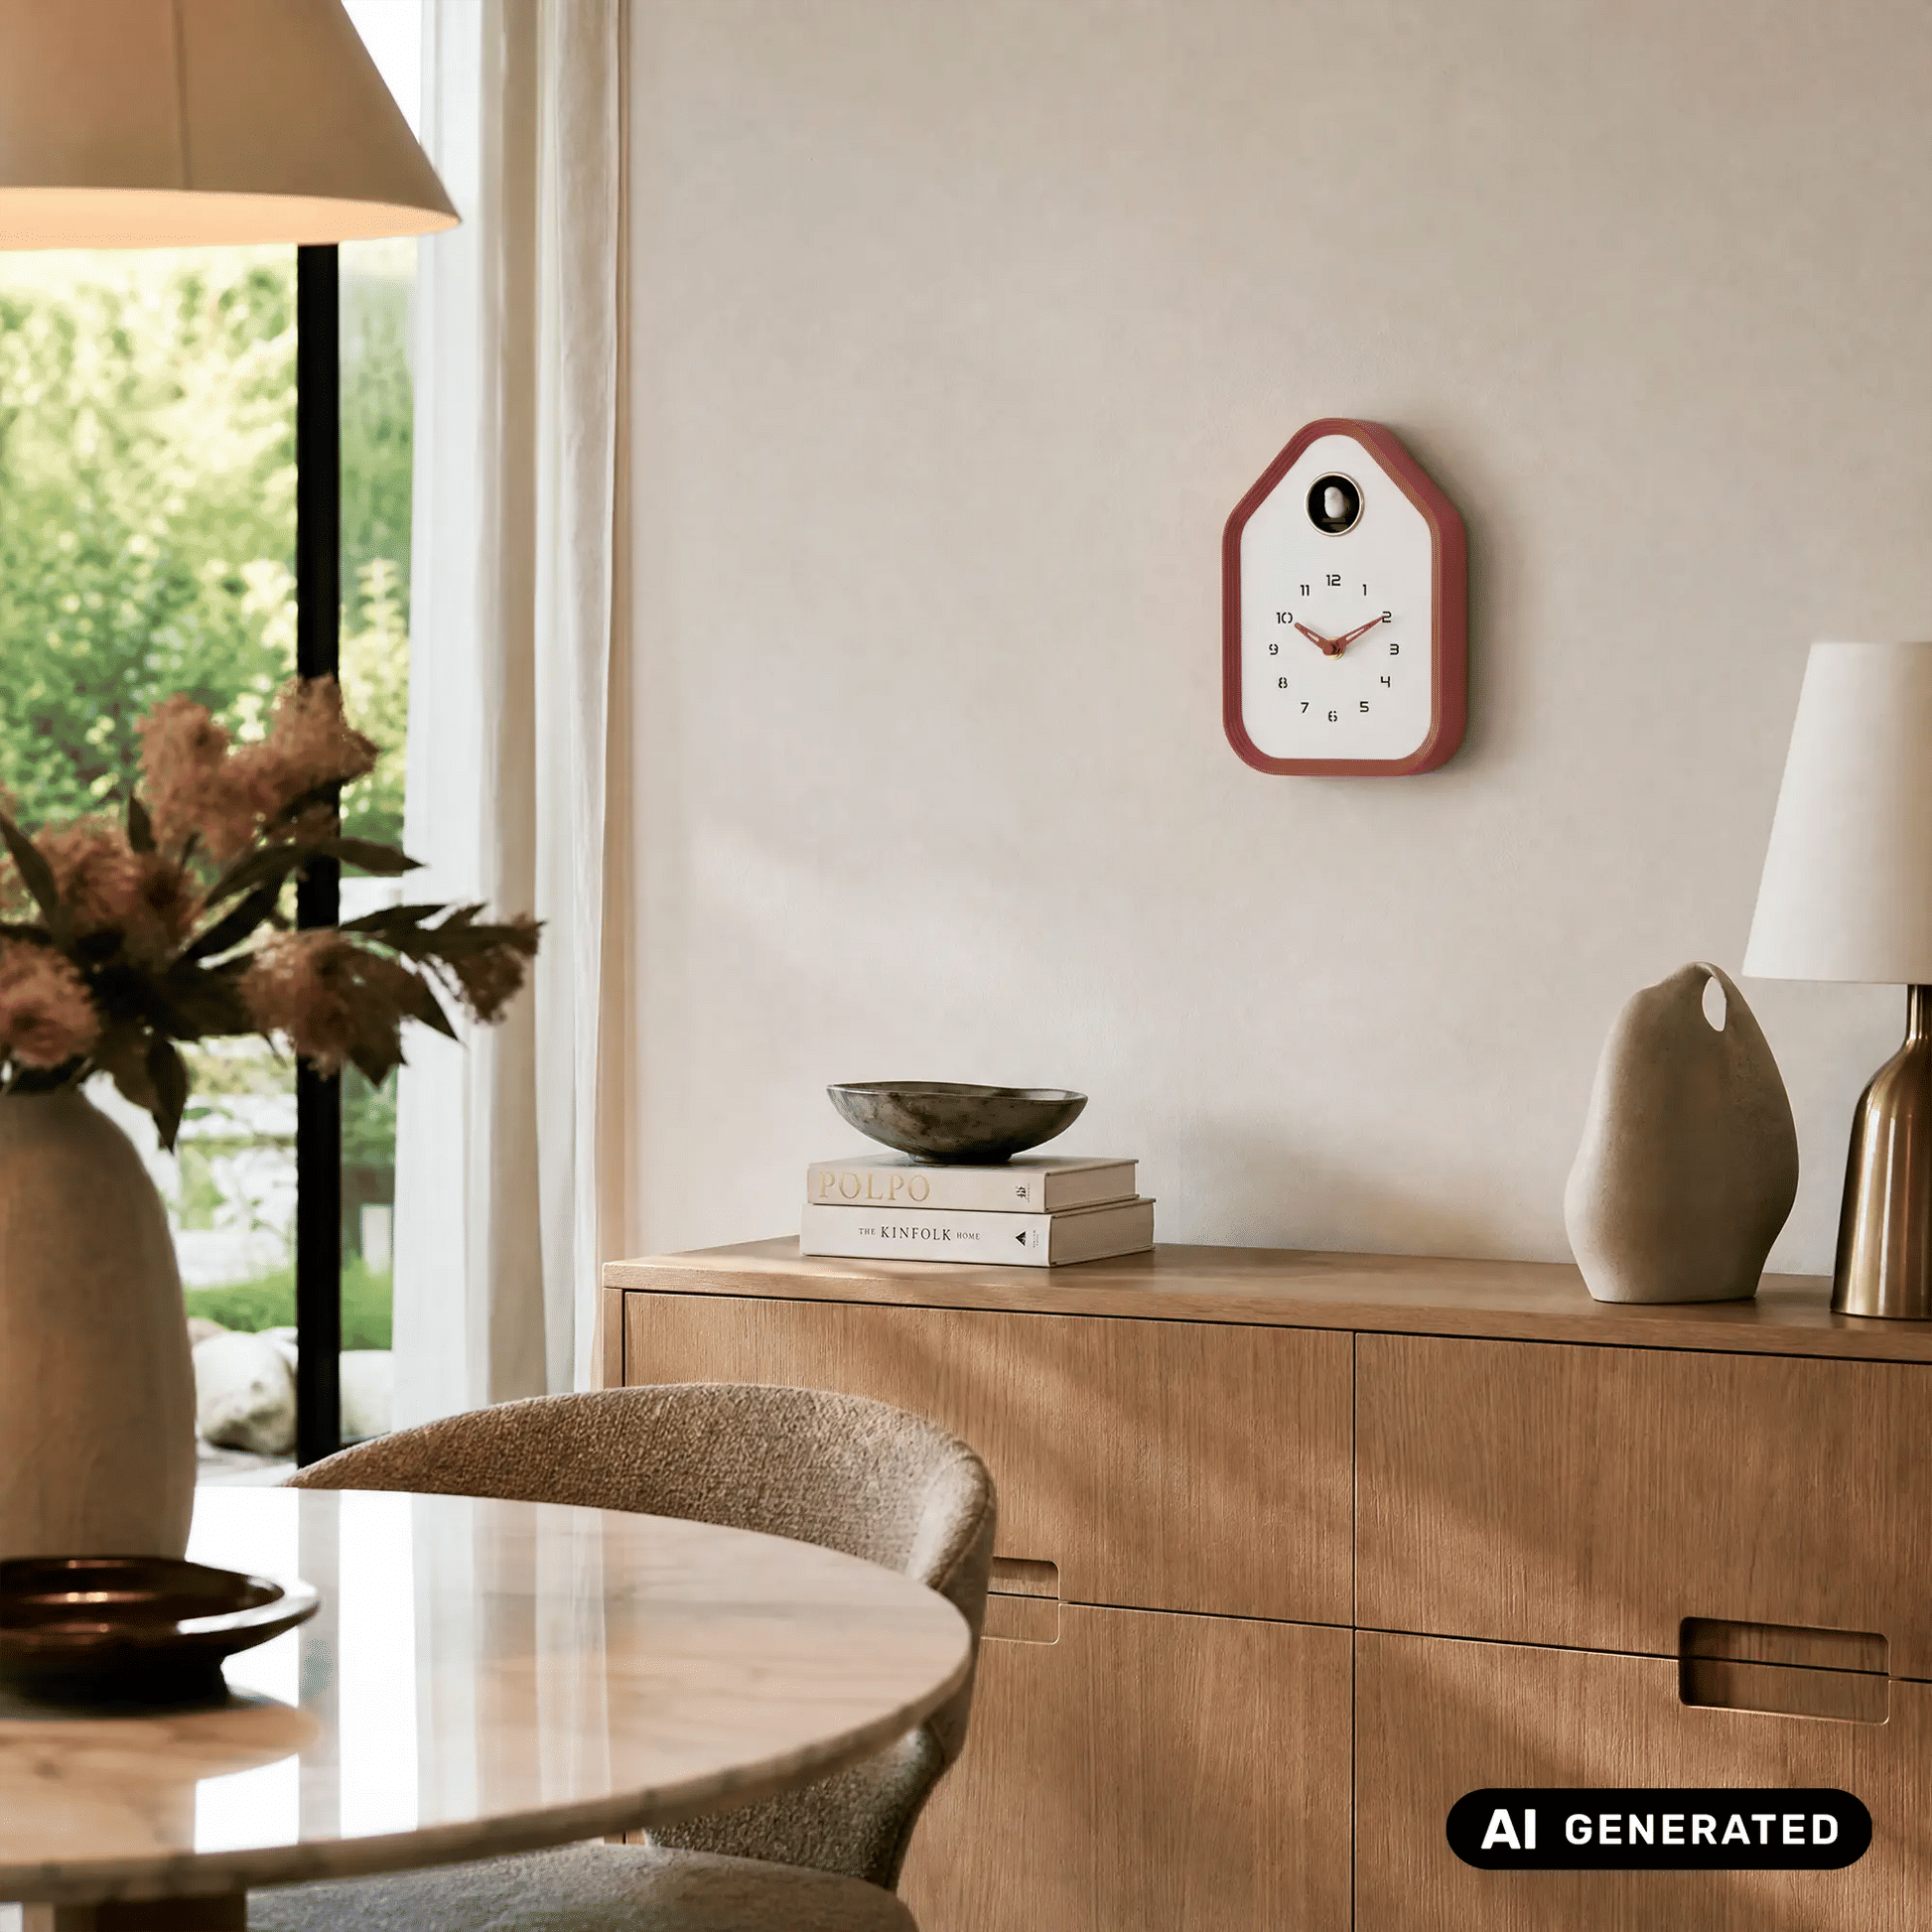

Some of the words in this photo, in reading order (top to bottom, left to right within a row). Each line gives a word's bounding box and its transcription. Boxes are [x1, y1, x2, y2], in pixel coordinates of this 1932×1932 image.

[1325, 574, 1341, 587] 12
[1300, 584, 1311, 597] 11
[1362, 584, 1367, 597] 1
[1276, 612, 1294, 624] 10
[1382, 611, 1392, 623] 2
[1268, 643, 1279, 655] 9
[1389, 643, 1400, 655] 3
[1278, 676, 1289, 689] 8
[1380, 676, 1391, 688] 4
[1300, 701, 1310, 714] 7
[1359, 701, 1370, 713] 5
[1327, 710, 1338, 723] 6
[819, 1171, 930, 1202] POLPO
[881, 1226, 950, 1241] KINFOLK
